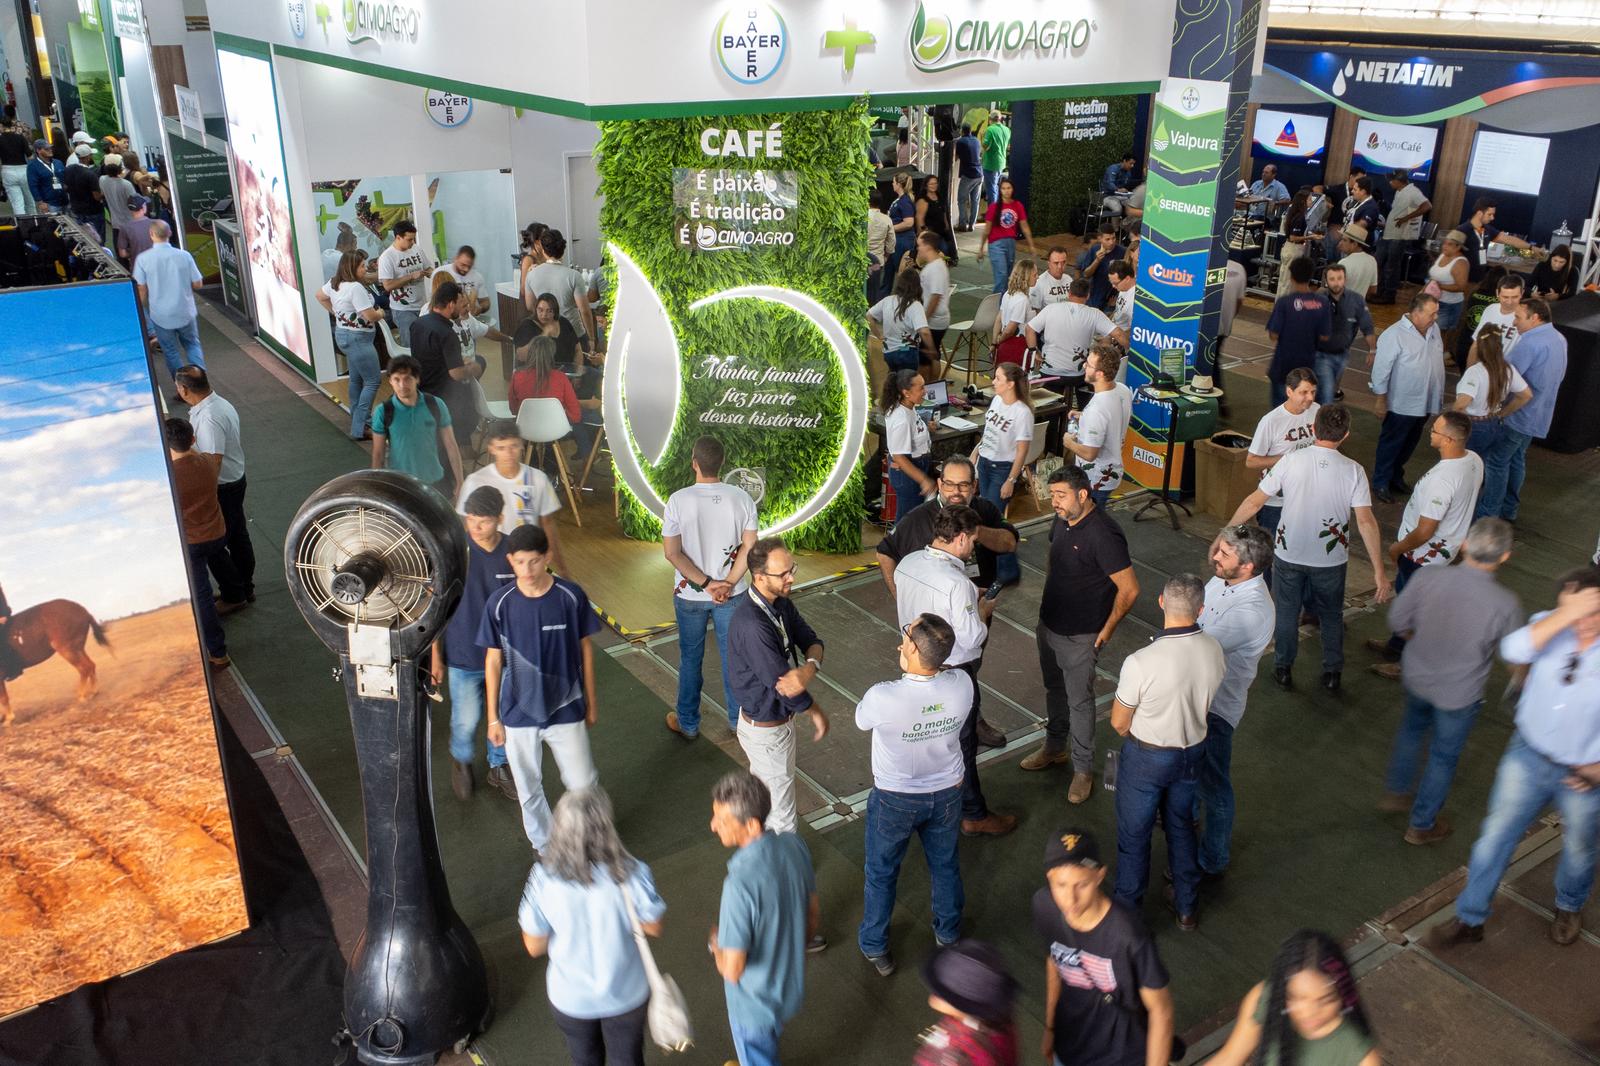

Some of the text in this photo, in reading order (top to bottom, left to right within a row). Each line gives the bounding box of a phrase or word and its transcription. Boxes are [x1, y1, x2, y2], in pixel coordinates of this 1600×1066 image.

[358, 2, 416, 37] CIMOAGRO
[724, 35, 780, 49] BAYER
[955, 18, 1090, 52] CIMOAGRO
[1355, 61, 1455, 88] NETAFIM
[429, 97, 468, 107] BAYER
[443, 91, 454, 124] AYER
[1065, 99, 1108, 115] Netafim
[700, 123, 782, 157] CAFÉ
[1063, 124, 1107, 140] irrigação
[1170, 130, 1218, 151] Valpura
[696, 170, 778, 195] É paixão
[690, 198, 785, 224] É tradição
[1160, 198, 1211, 217] SERENADE
[680, 224, 794, 245] É CIMOAGRO
[399, 252, 422, 268] CAFÉ
[1153, 263, 1193, 284] Curbix
[1132, 327, 1194, 356] SIVANTO
[693, 358, 825, 386] Minha família
[715, 387, 797, 407] faz parte
[699, 409, 822, 428] dessa história!
[1134, 448, 1161, 467] Alion
[902, 730, 930, 738] banco
[913, 716, 958, 732] O maior
